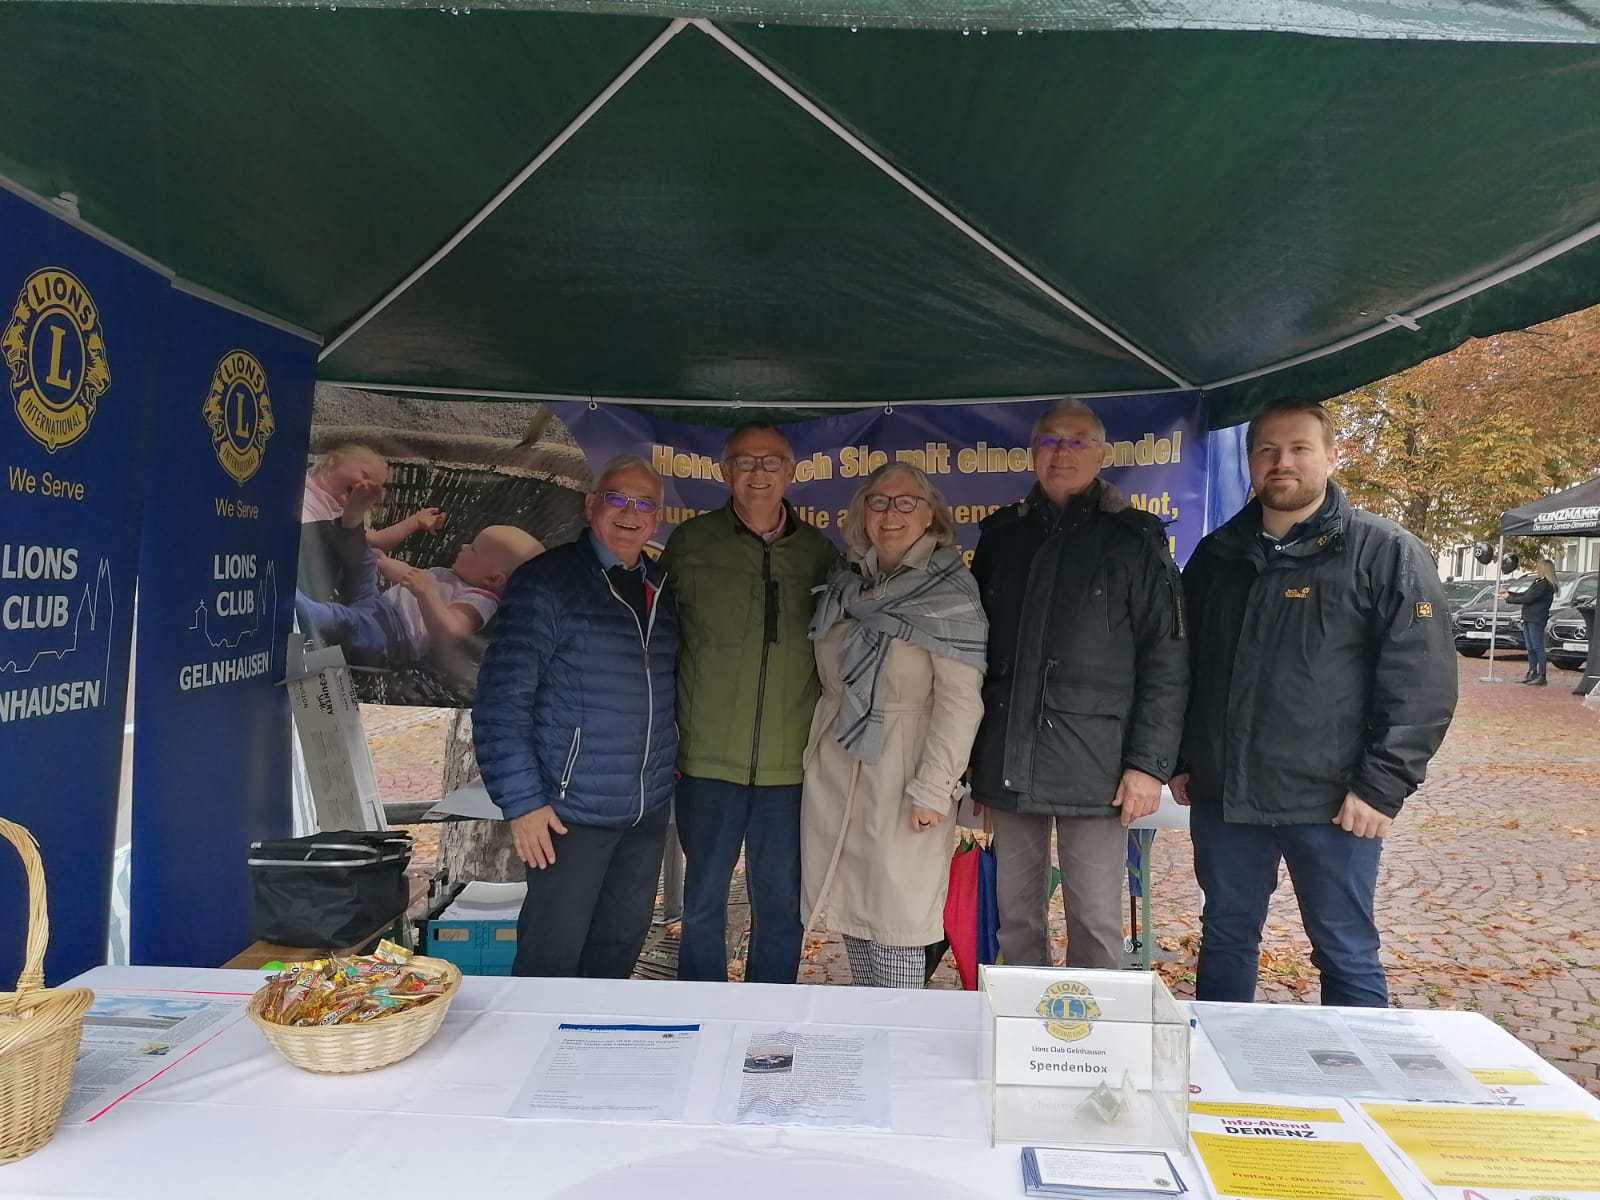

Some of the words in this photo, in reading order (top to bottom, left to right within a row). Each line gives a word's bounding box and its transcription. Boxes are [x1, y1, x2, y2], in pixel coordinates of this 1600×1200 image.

[31, 277, 92, 325] LIONS
[46, 324, 72, 390] L
[224, 356, 262, 389] LIONS
[22, 398, 83, 437] INTERNATIONAL
[235, 391, 250, 438] L
[222, 447, 257, 473] INTERNATIONAL
[840, 445, 888, 478] Sie
[896, 442, 951, 474] mit
[1100, 431, 1182, 468] ende!
[9, 465, 35, 494] We
[41, 472, 85, 500] Serve
[215, 497, 234, 518] We
[236, 500, 259, 520] Serve
[1130, 491, 1179, 519] Not,
[2, 544, 78, 580] LIONS
[214, 554, 257, 580] LIONS
[2, 595, 69, 630] CLUB
[216, 589, 254, 617] CLUB
[179, 651, 269, 691] GELNHAUSEN
[1050, 983, 1088, 995] LIONS
[1066, 1047, 1106, 1056] Gelnhausen
[1029, 1060, 1108, 1074] Spendenbox
[1221, 1119, 1311, 1129] Info-Abend
[1225, 1126, 1318, 1138] DEMENZ
